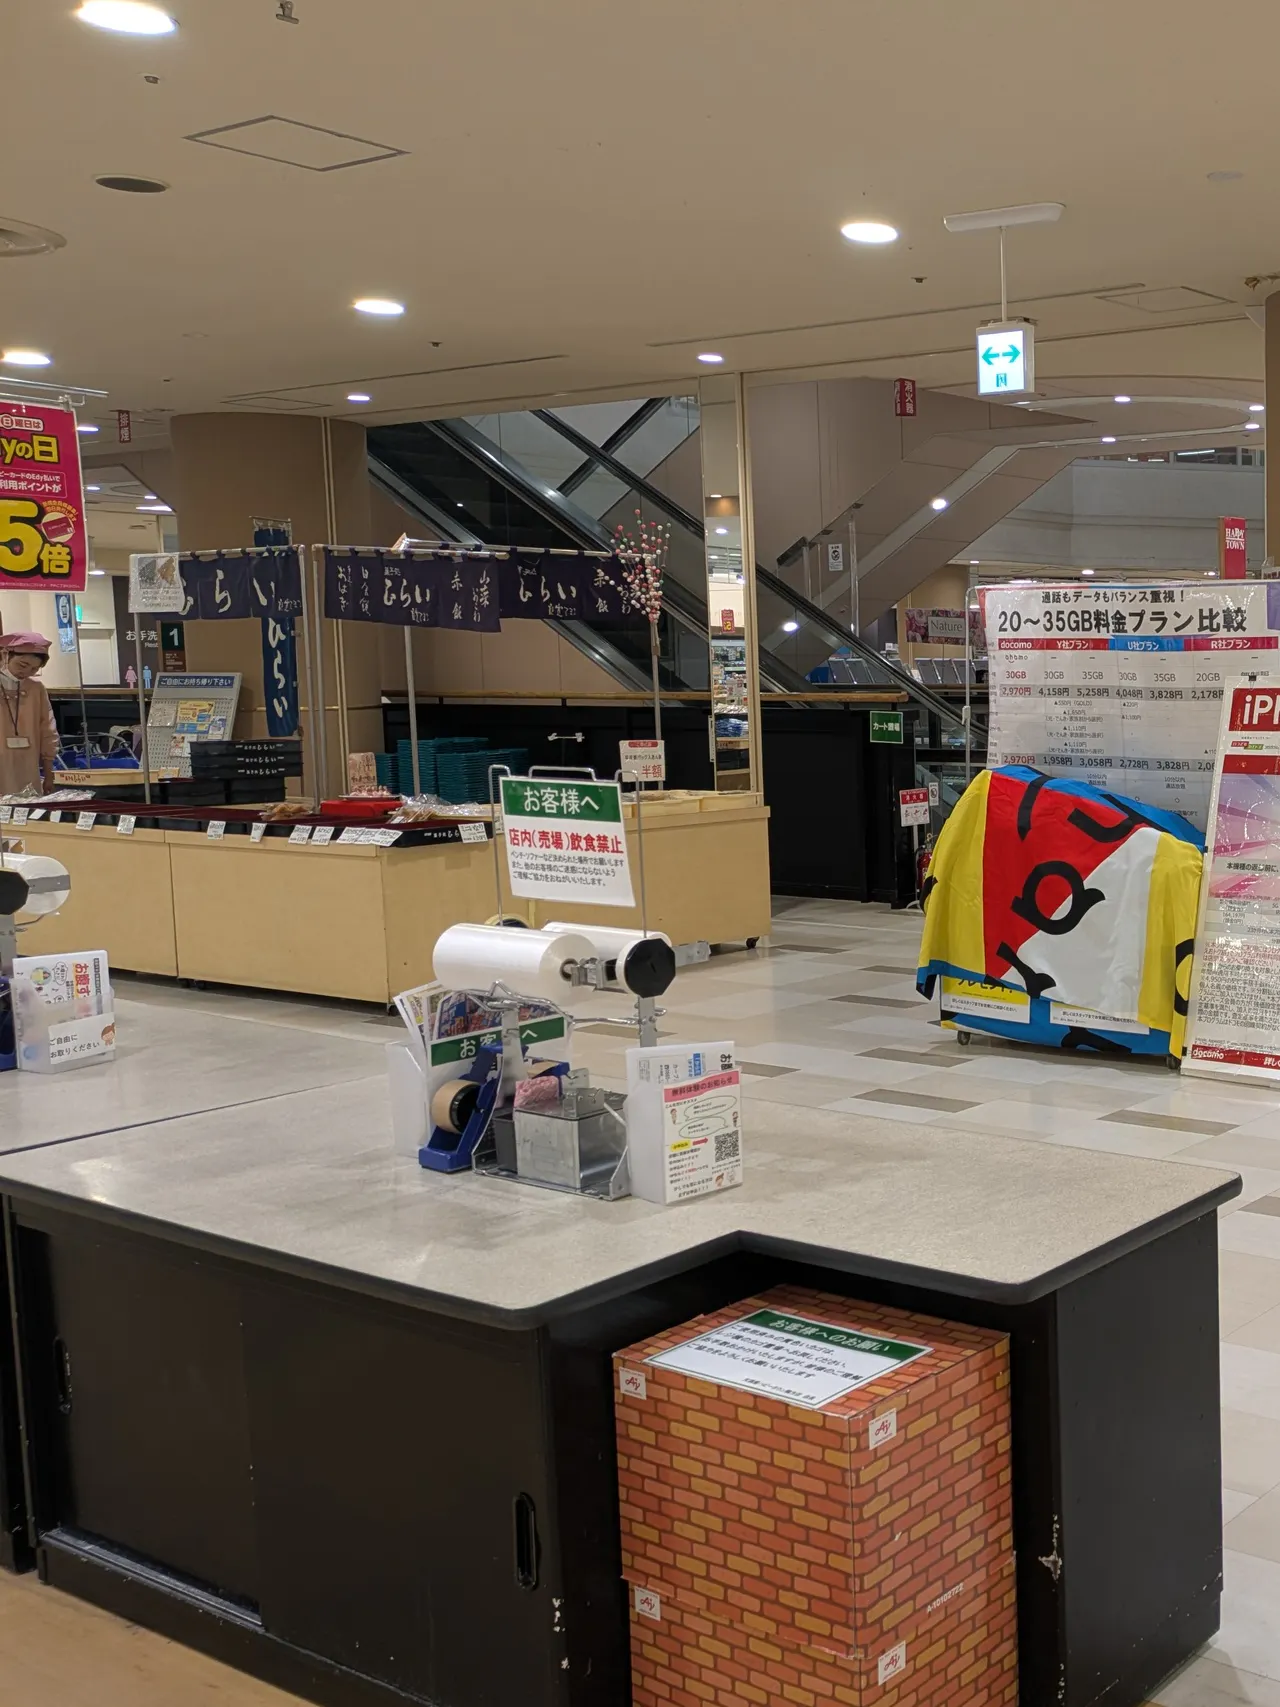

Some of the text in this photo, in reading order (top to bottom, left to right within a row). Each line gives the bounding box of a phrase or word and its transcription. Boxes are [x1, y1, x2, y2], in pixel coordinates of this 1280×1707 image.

[0, 435, 58, 463] yの日
[1225, 528, 1245, 538] HAPPY
[1226, 540, 1245, 550] TOWN
[930, 618, 963, 632] Nature
[169, 628, 179, 646] 1
[1000, 639, 1251, 650] docomo Y社プラン U社プラン R社プラン
[1005, 671, 1220, 682] 30GB 30GB 35GB 30GB 35GB 20GB
[1002, 687, 1031, 697] 2,970円
[1038, 688, 1069, 698] 4,158円
[1077, 688, 1109, 698] 5,258円
[1115, 689, 1143, 699] 4,048円
[1150, 690, 1183, 699] 3,828円
[1004, 755, 1035, 765] 2,970円
[1043, 756, 1072, 766] 1,958円
[1080, 758, 1112, 768] 3,058円
[1119, 760, 1149, 769] 2,728円
[1156, 761, 1190, 770] 3,828円
[524, 787, 599, 815] お客様へ
[50, 1033, 78, 1046] ご自由に
[460, 1029, 538, 1059] お客へ
[50, 1040, 100, 1059] お取りください
[1192, 1047, 1224, 1059] docomo
[769, 1319, 890, 1352] お客様へのお願い
